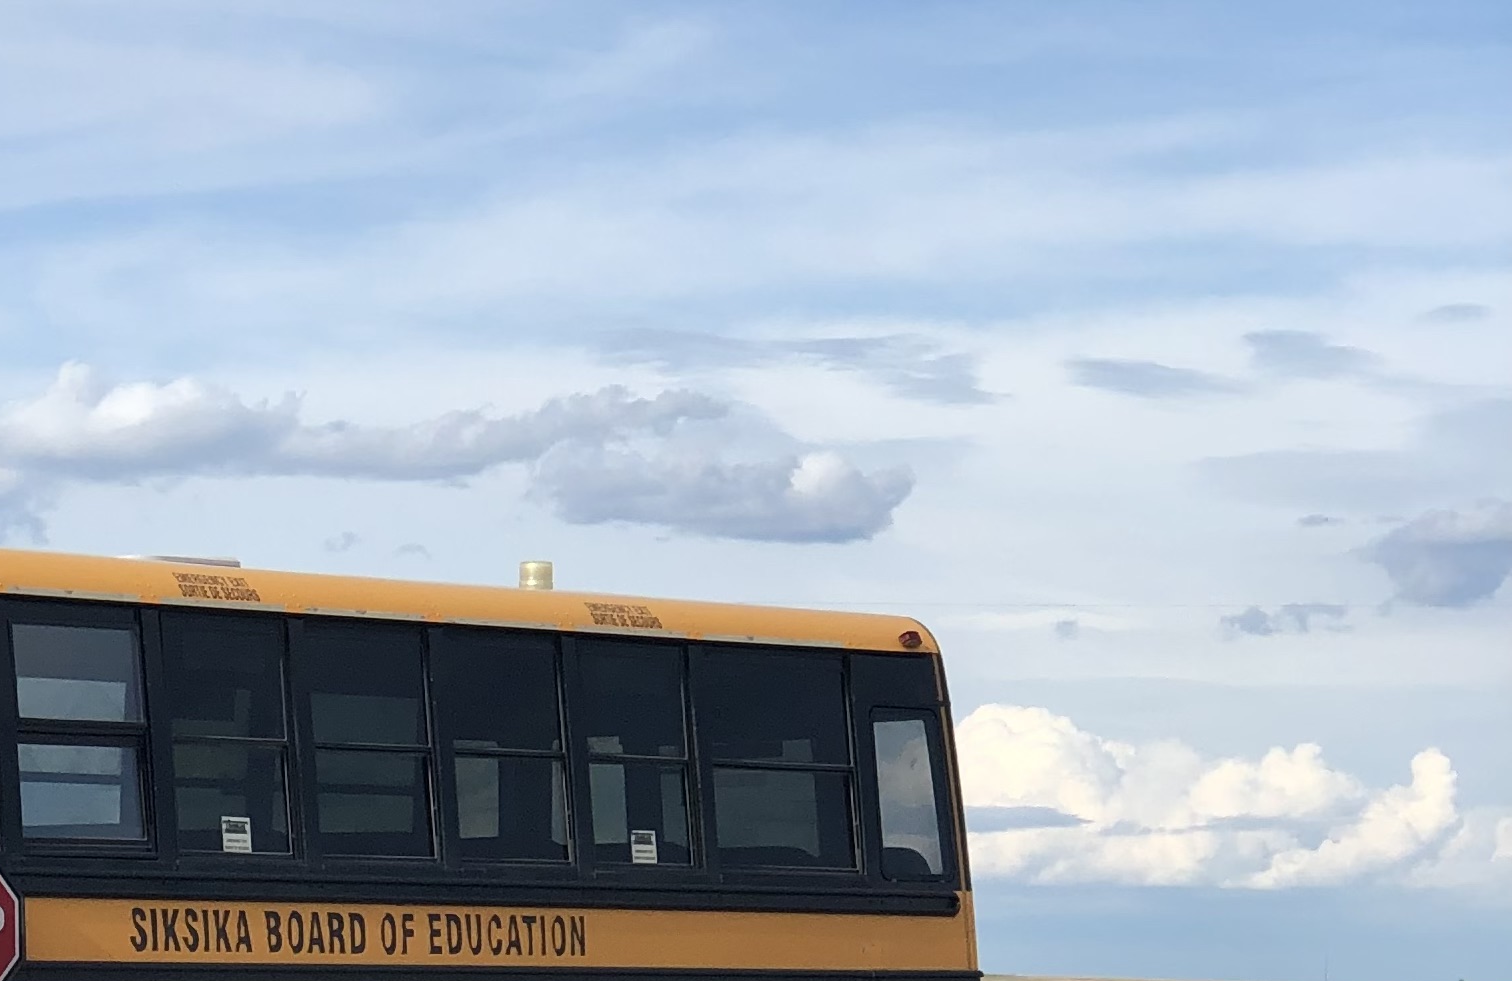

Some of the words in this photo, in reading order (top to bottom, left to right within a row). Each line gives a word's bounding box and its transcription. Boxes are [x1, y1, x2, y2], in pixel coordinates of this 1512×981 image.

[172, 572, 229, 586] EMERGENCY
[178, 584, 210, 598] SORTIE
[208, 586, 223, 599] DE
[220, 587, 261, 602] SECOURS
[130, 907, 253, 953] SIKSIKA
[264, 910, 366, 954] BOARD
[381, 912, 415, 955] OF
[428, 913, 586, 957] EDUCATION
